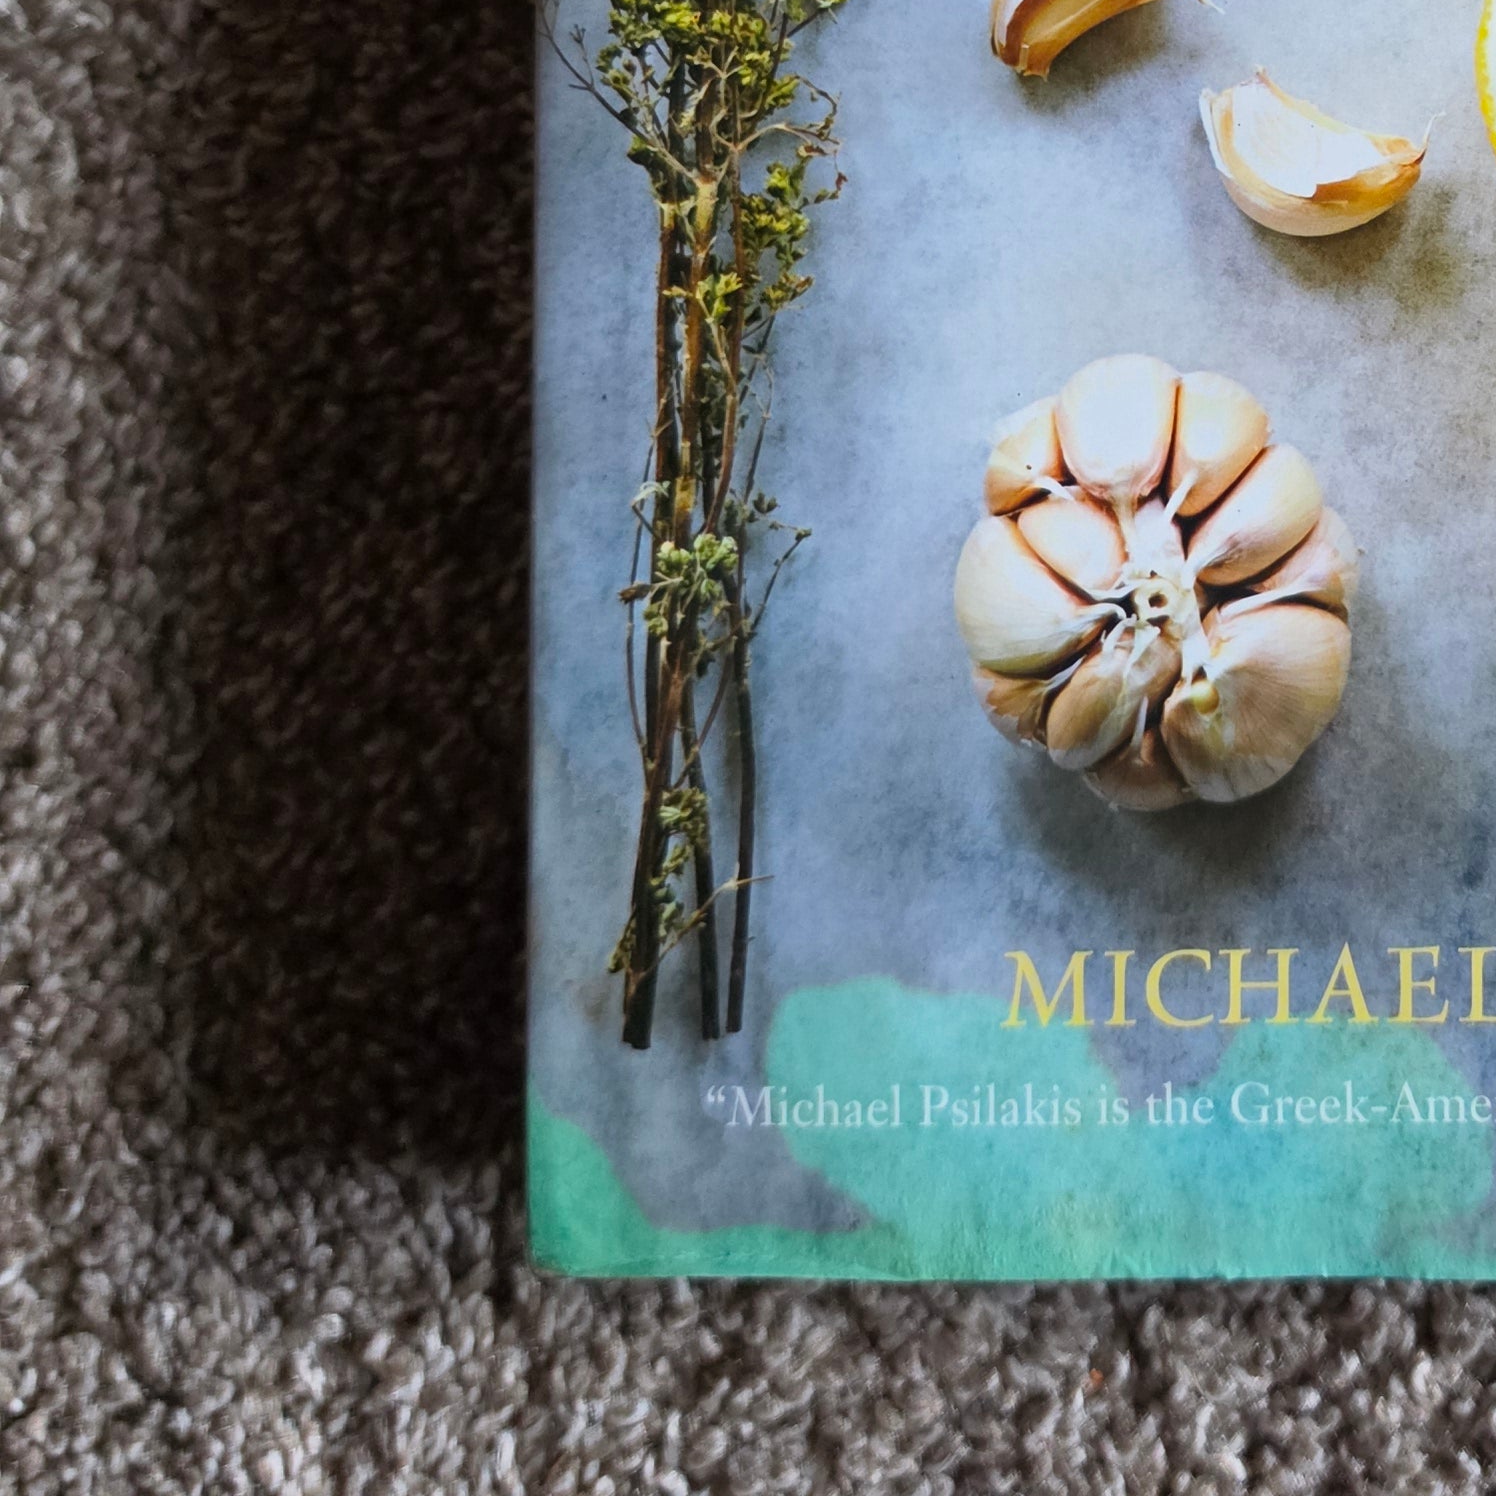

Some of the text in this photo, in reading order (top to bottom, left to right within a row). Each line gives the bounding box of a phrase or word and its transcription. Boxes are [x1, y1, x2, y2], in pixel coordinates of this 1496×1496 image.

[705, 1082, 903, 1129] “Michael
[919, 1082, 1085, 1128] Psilakis
[1098, 1084, 1132, 1126] is
[1146, 1083, 1215, 1126] the
